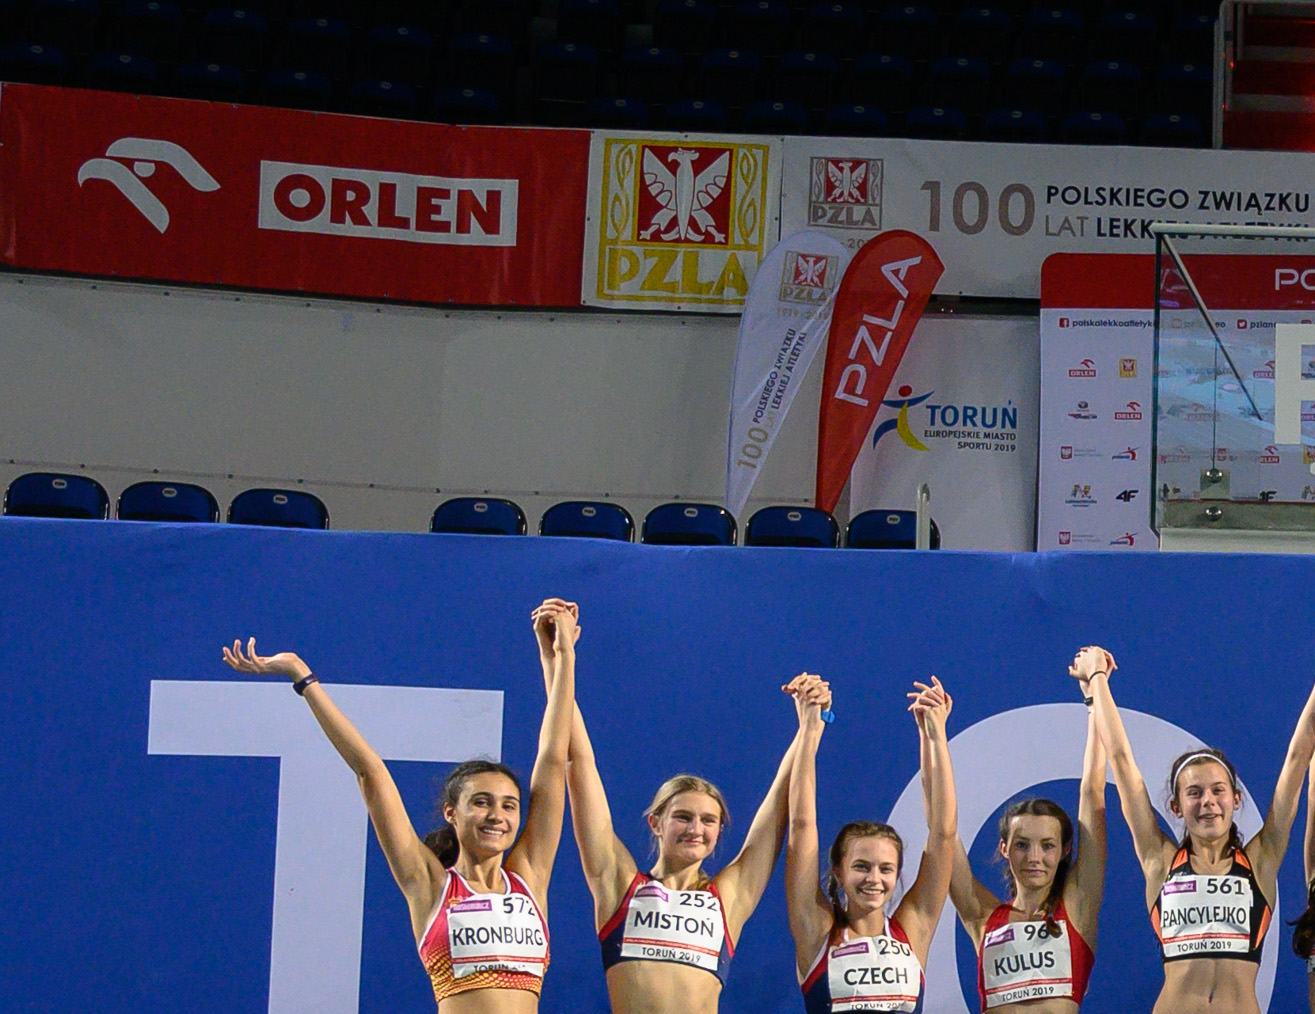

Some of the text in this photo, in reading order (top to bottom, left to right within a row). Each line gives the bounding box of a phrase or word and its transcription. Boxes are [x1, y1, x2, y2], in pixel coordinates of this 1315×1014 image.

[274, 172, 502, 236] ORLEN
[920, 180, 1310, 236] 100 POLSKIEGO ZWIĄZKU
[811, 204, 878, 227] PZLA
[1045, 215, 1089, 237] LAT
[606, 249, 750, 298] PZLA
[834, 256, 922, 407] PZLA
[1072, 319, 1154, 328] polskalekkoatletyk
[771, 332, 807, 410] LEKKIEJ ATLETYKI
[737, 328, 796, 470] 100 POLSKIEGO ZWIĄZKU
[925, 400, 1018, 430] TORUŃ
[924, 429, 1017, 441] EUROPEJSKIE MIASTO
[957, 441, 1016, 452] SPORTU 2019
[1116, 490, 1138, 501] 4F
[1206, 878, 1245, 895] 561
[680, 893, 719, 911] 252
[634, 911, 714, 938] MISTOŃ
[1163, 906, 1247, 928] PANCYLEJKO
[453, 926, 543, 947] KRONBURG
[1177, 939, 1232, 953] TORUŃ 2019
[642, 945, 677, 960] TORUŃ
[679, 951, 701, 964] 2019
[994, 951, 1055, 976] KULUS
[844, 967, 908, 986] CZECH
[1001, 988, 1030, 1002] TORUŃ
[1032, 986, 1054, 997] 2019
[850, 1000, 884, 1010] TORUŃ
